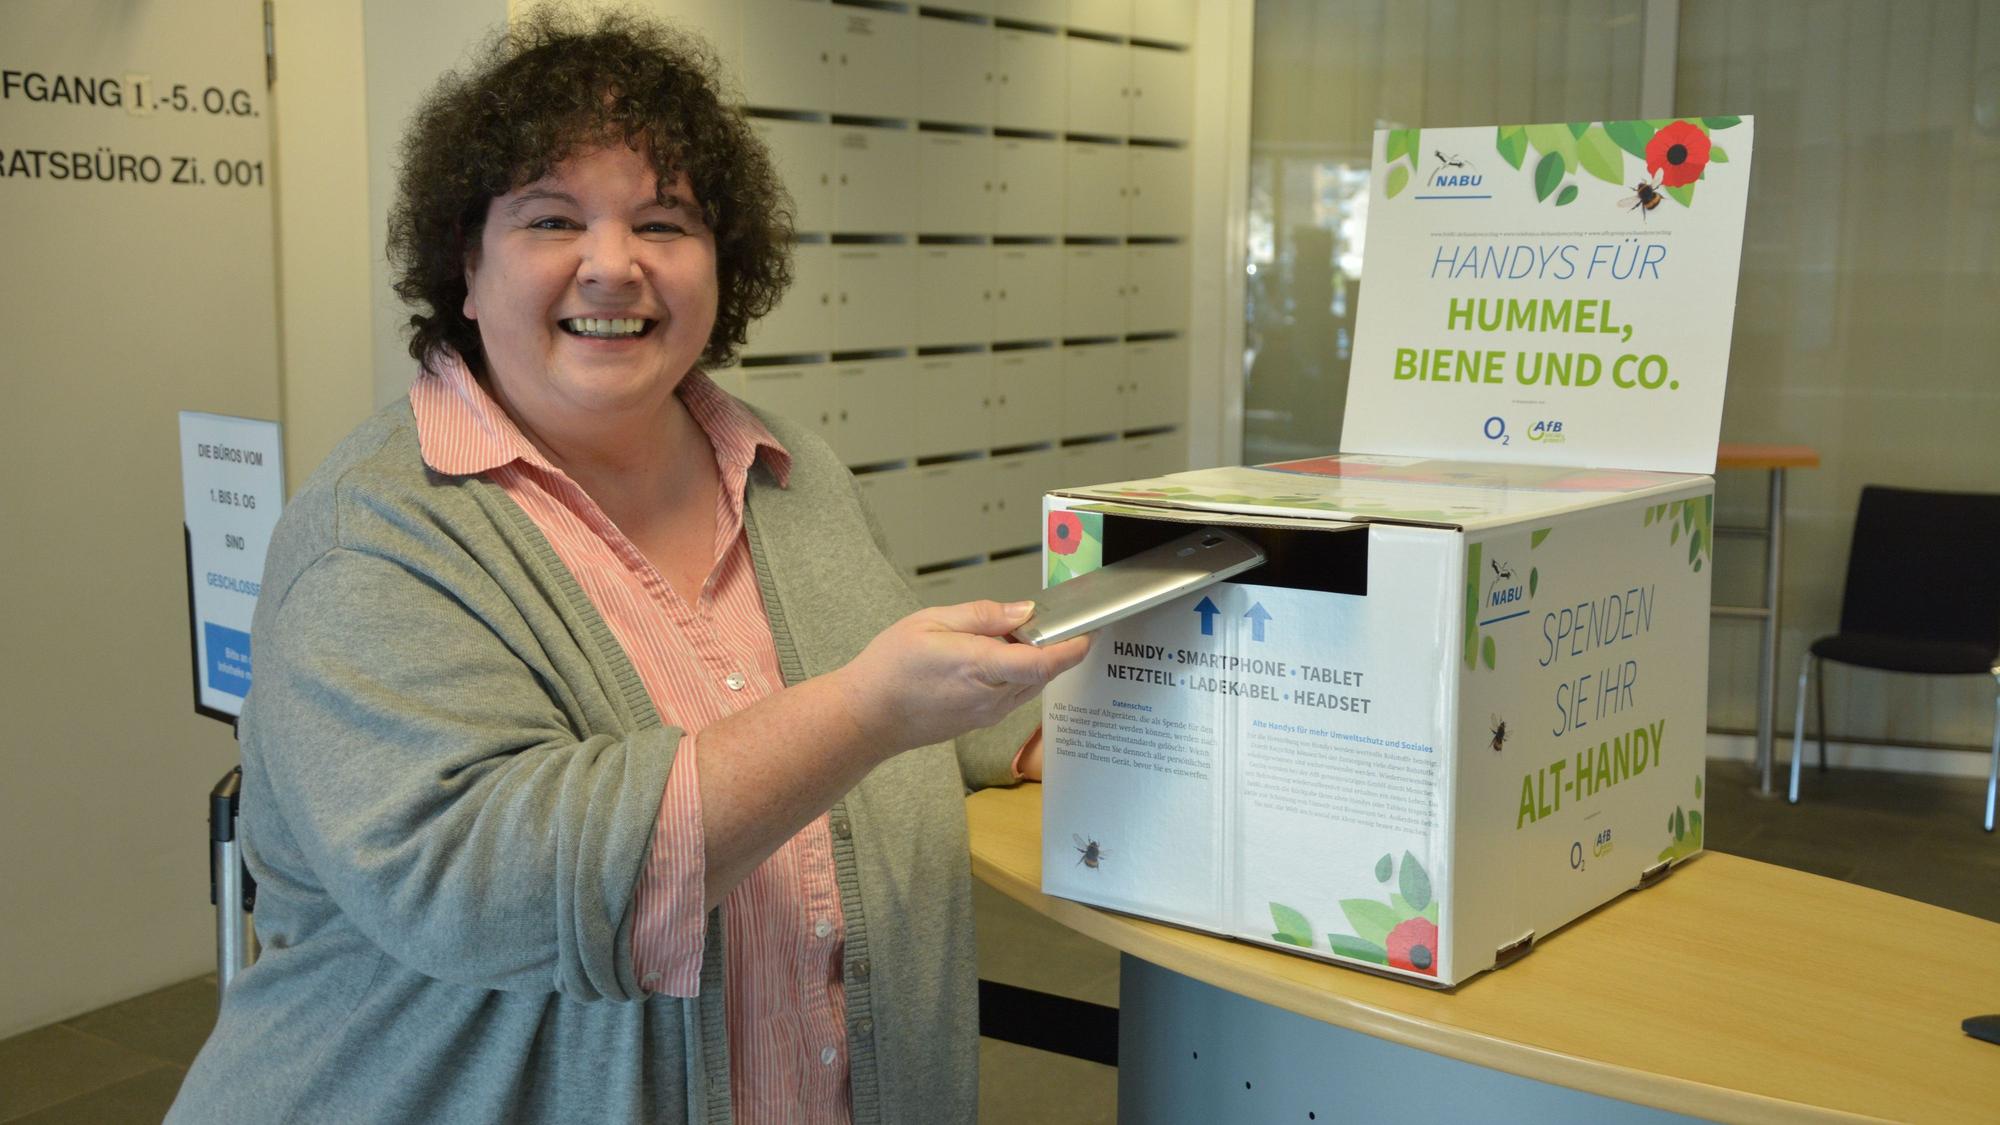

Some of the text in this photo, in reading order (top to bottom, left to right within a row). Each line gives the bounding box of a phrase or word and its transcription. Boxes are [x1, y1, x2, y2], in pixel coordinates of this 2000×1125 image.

[2, 70, 122, 107] FGANG
[203, 87, 260, 118] O.G.
[0, 147, 264, 187] ATSBÜRO Zi. 001
[1435, 174, 1483, 188] NABU
[1430, 238, 1667, 280] HANDYS FÜR
[1447, 297, 1634, 343] HUMMEL,
[1393, 348, 1680, 390] BIENE UND CO.
[1534, 420, 1562, 432] AfB
[198, 443, 263, 466] DIE BÜROS VOM
[210, 489, 256, 509] 1. BIS 5. OG
[225, 534, 245, 550] SIND
[1491, 585, 1523, 607] NABU
[1538, 584, 1655, 667] SPENDEN
[1113, 640, 1364, 688] HANDY SMARTPHONE TABLET
[1107, 663, 1371, 714] NETZTEIL LADEKABEL HEADSET
[1112, 700, 1152, 712] Datenschutz
[1553, 660, 1637, 737] SIE IHR
[1053, 702, 1066, 711] Alle
[1068, 704, 1087, 714] Daten
[1163, 719, 1186, 729] Spende
[1252, 719, 1433, 753] Alte Handys für mehr Umweltschutz und Soziales
[1516, 718, 1666, 830] ALT-HANDY
[1596, 828, 1611, 846] AfB
